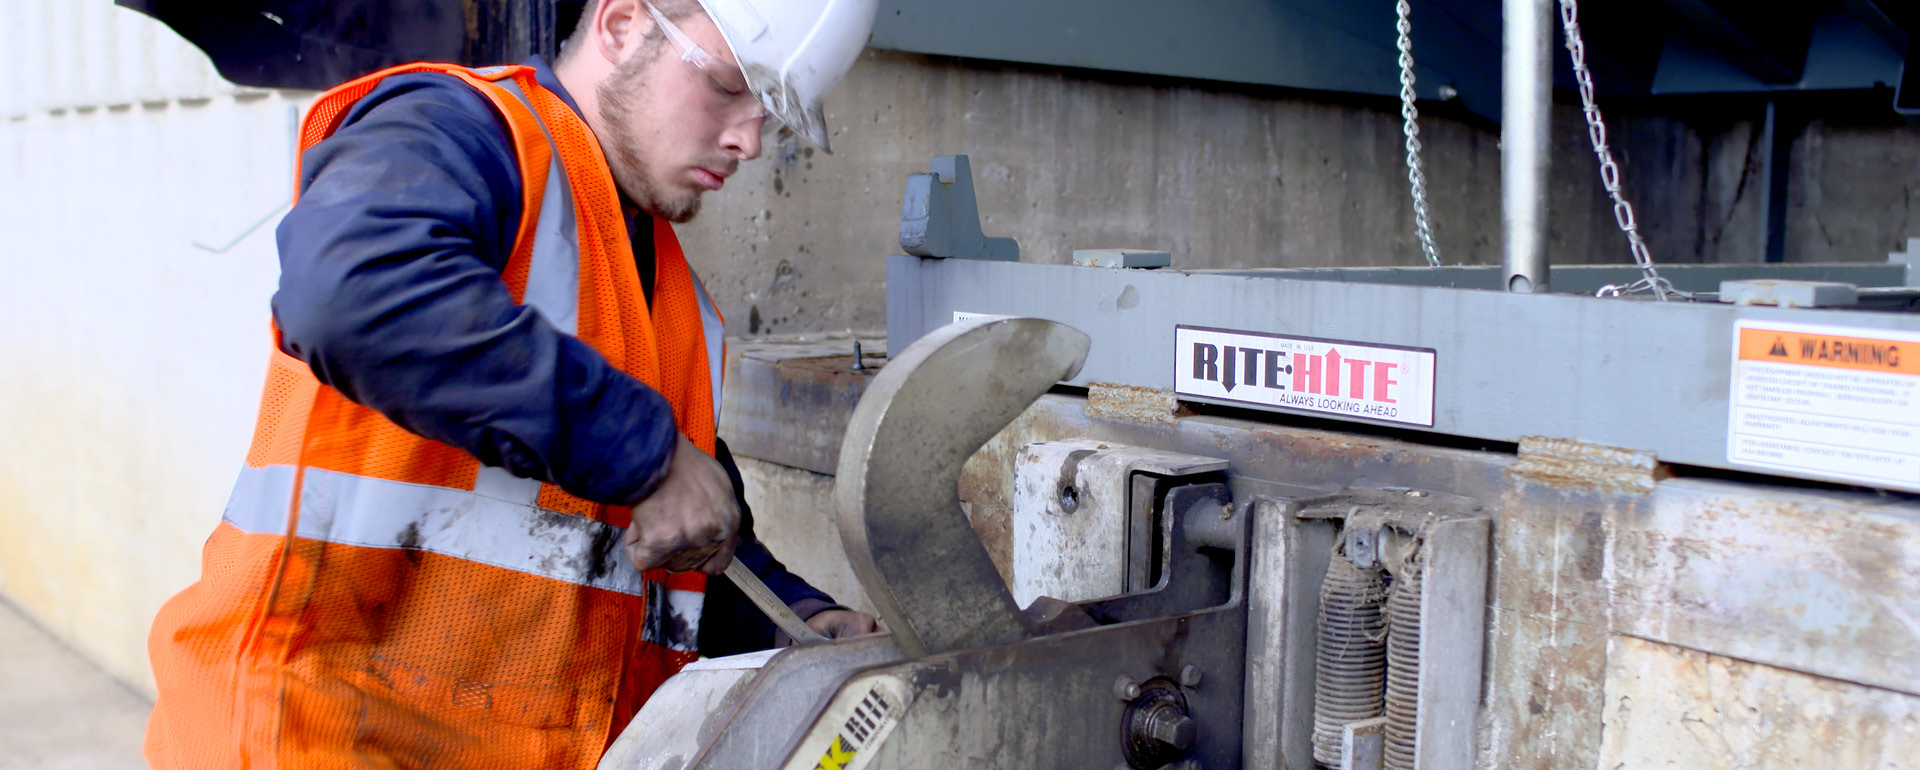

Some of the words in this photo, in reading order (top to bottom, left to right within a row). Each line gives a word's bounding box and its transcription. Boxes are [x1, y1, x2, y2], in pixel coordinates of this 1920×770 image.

[1799, 338, 1900, 368] WARNING
[1280, 393, 1315, 407] ALWAYS
[1317, 398, 1360, 413] LOOKING
[1363, 404, 1398, 418] AHEAD
